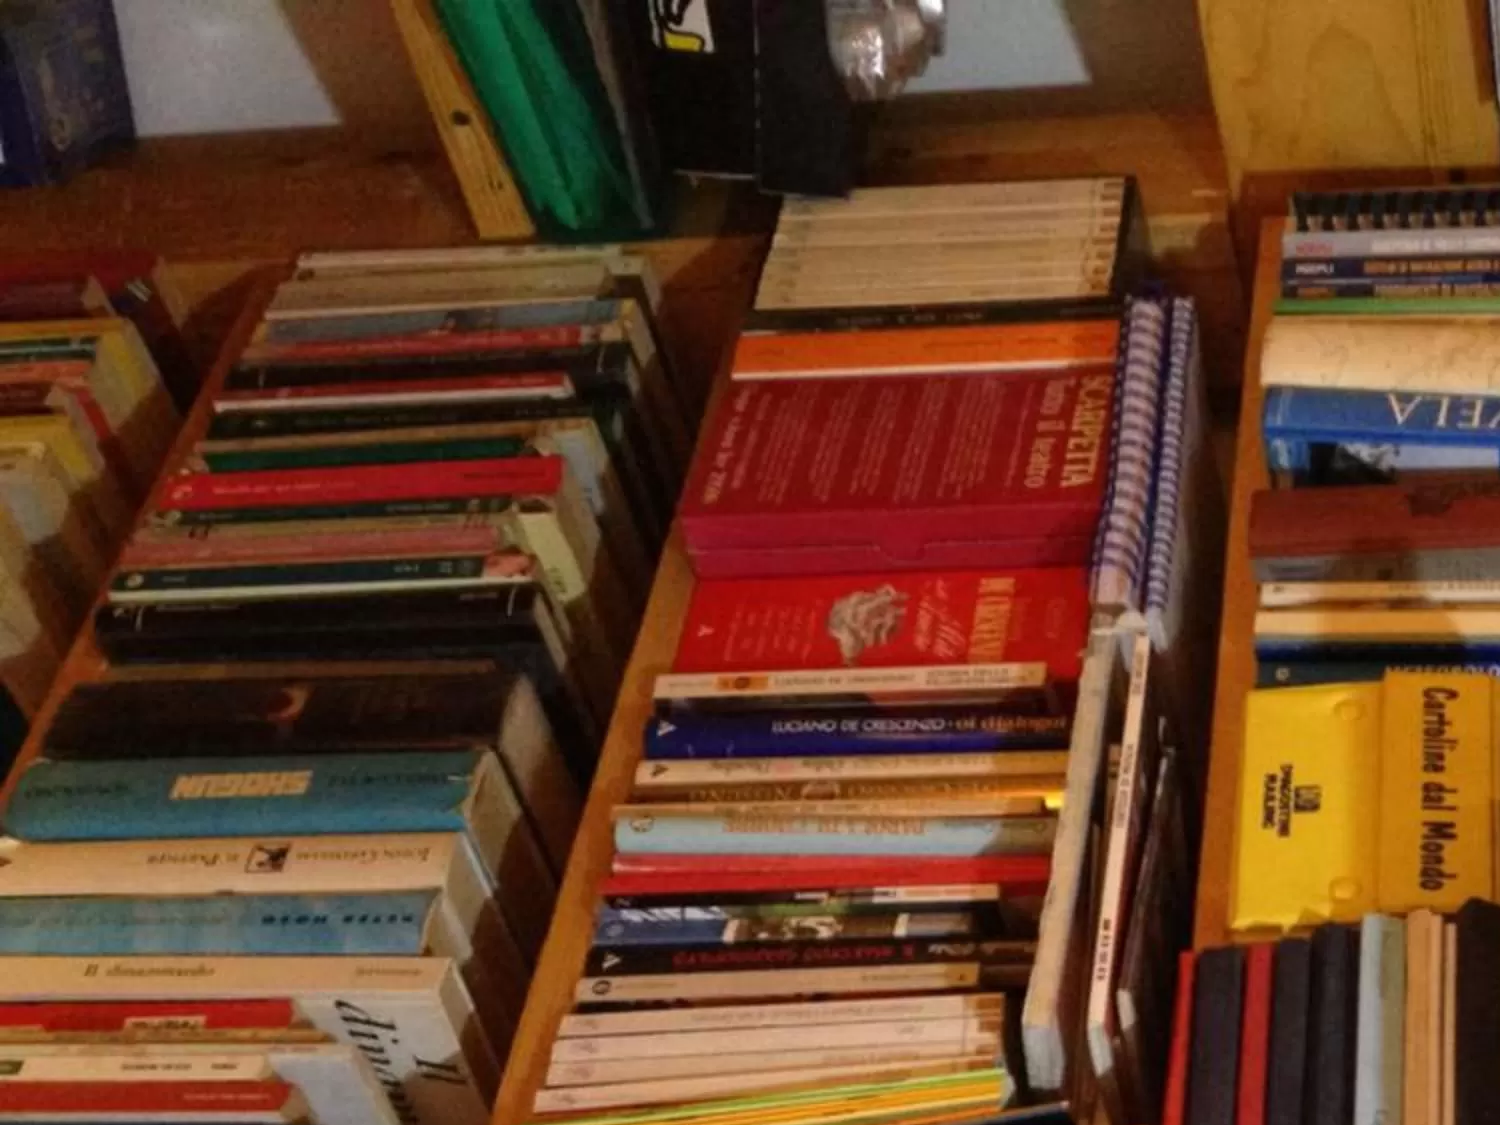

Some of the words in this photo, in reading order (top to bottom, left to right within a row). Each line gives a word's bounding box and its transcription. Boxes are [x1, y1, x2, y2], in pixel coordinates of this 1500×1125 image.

[1060, 375, 1113, 489] SCARPETTA
[771, 717, 836, 733] LUCIANO
[839, 718, 858, 732] DE
[862, 716, 946, 733] CRESCENZO
[1421, 687, 1460, 774] Cartoline
[1421, 782, 1458, 812] dal
[1419, 820, 1458, 891] Mondo
